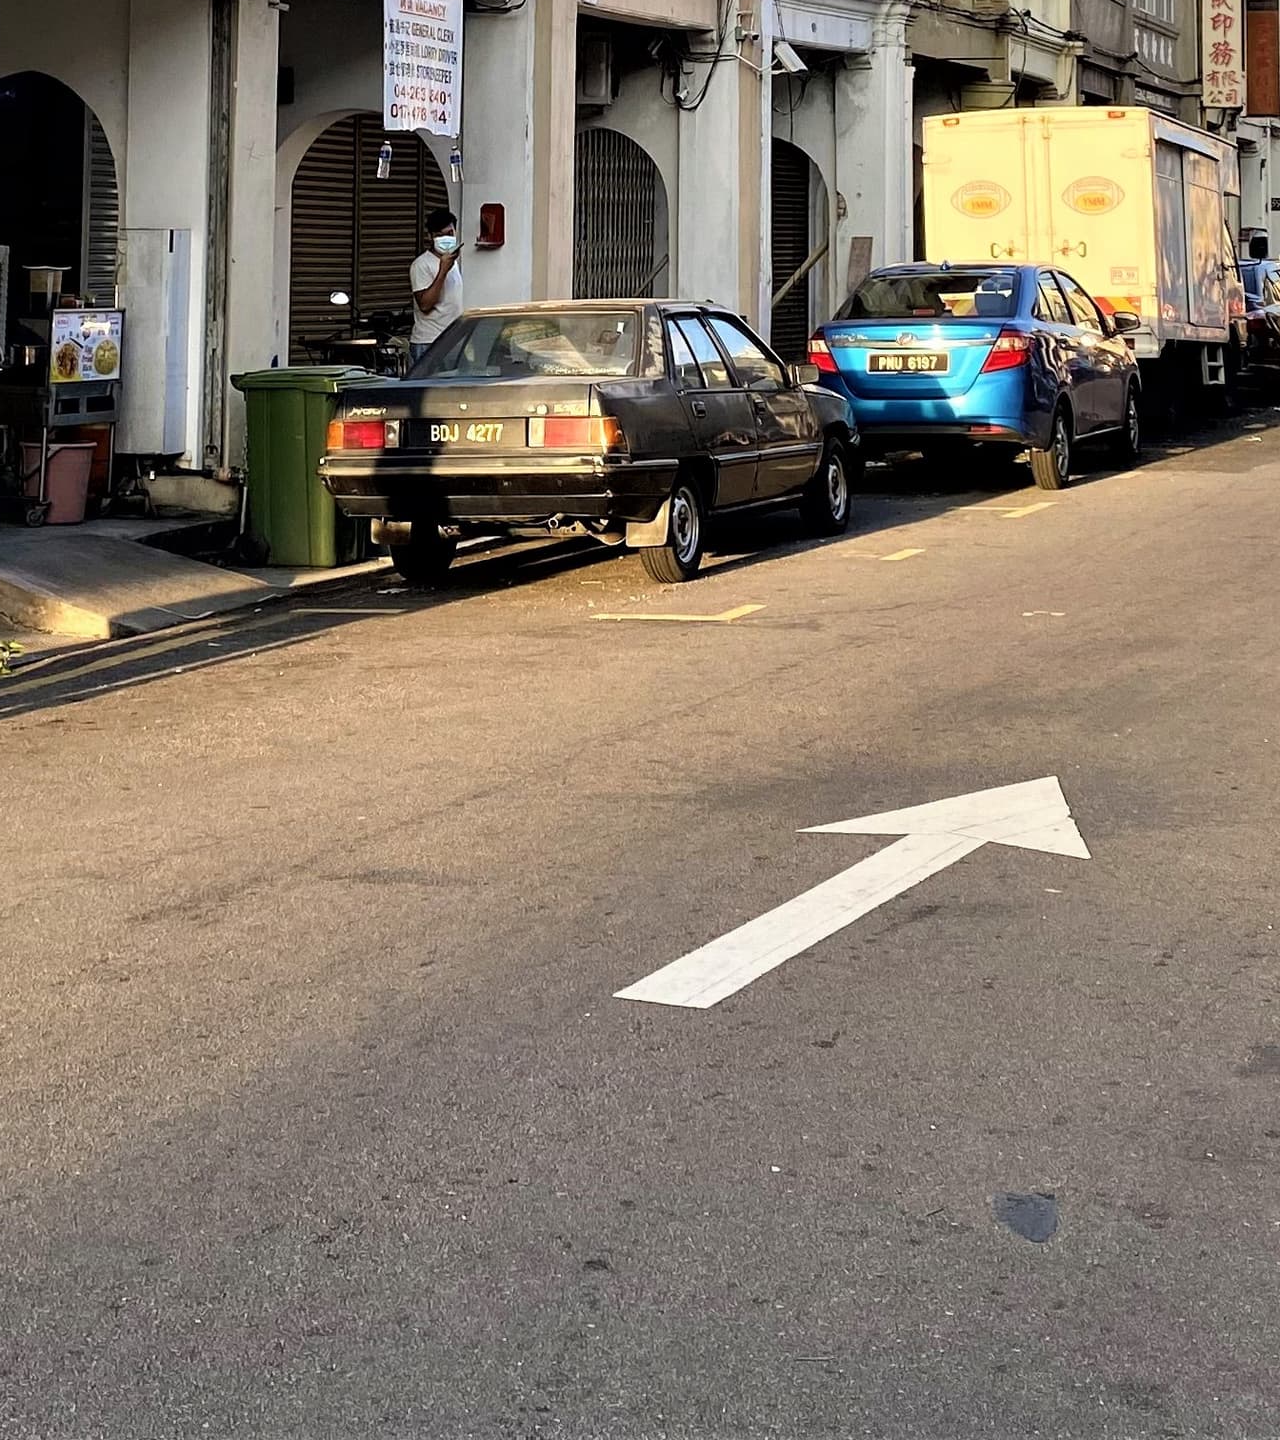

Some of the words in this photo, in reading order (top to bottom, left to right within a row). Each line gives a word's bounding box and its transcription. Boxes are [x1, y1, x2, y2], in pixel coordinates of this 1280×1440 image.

[907, 356, 938, 370] 6197
[430, 424, 460, 442] BDJ
[466, 423, 504, 442] 4277
